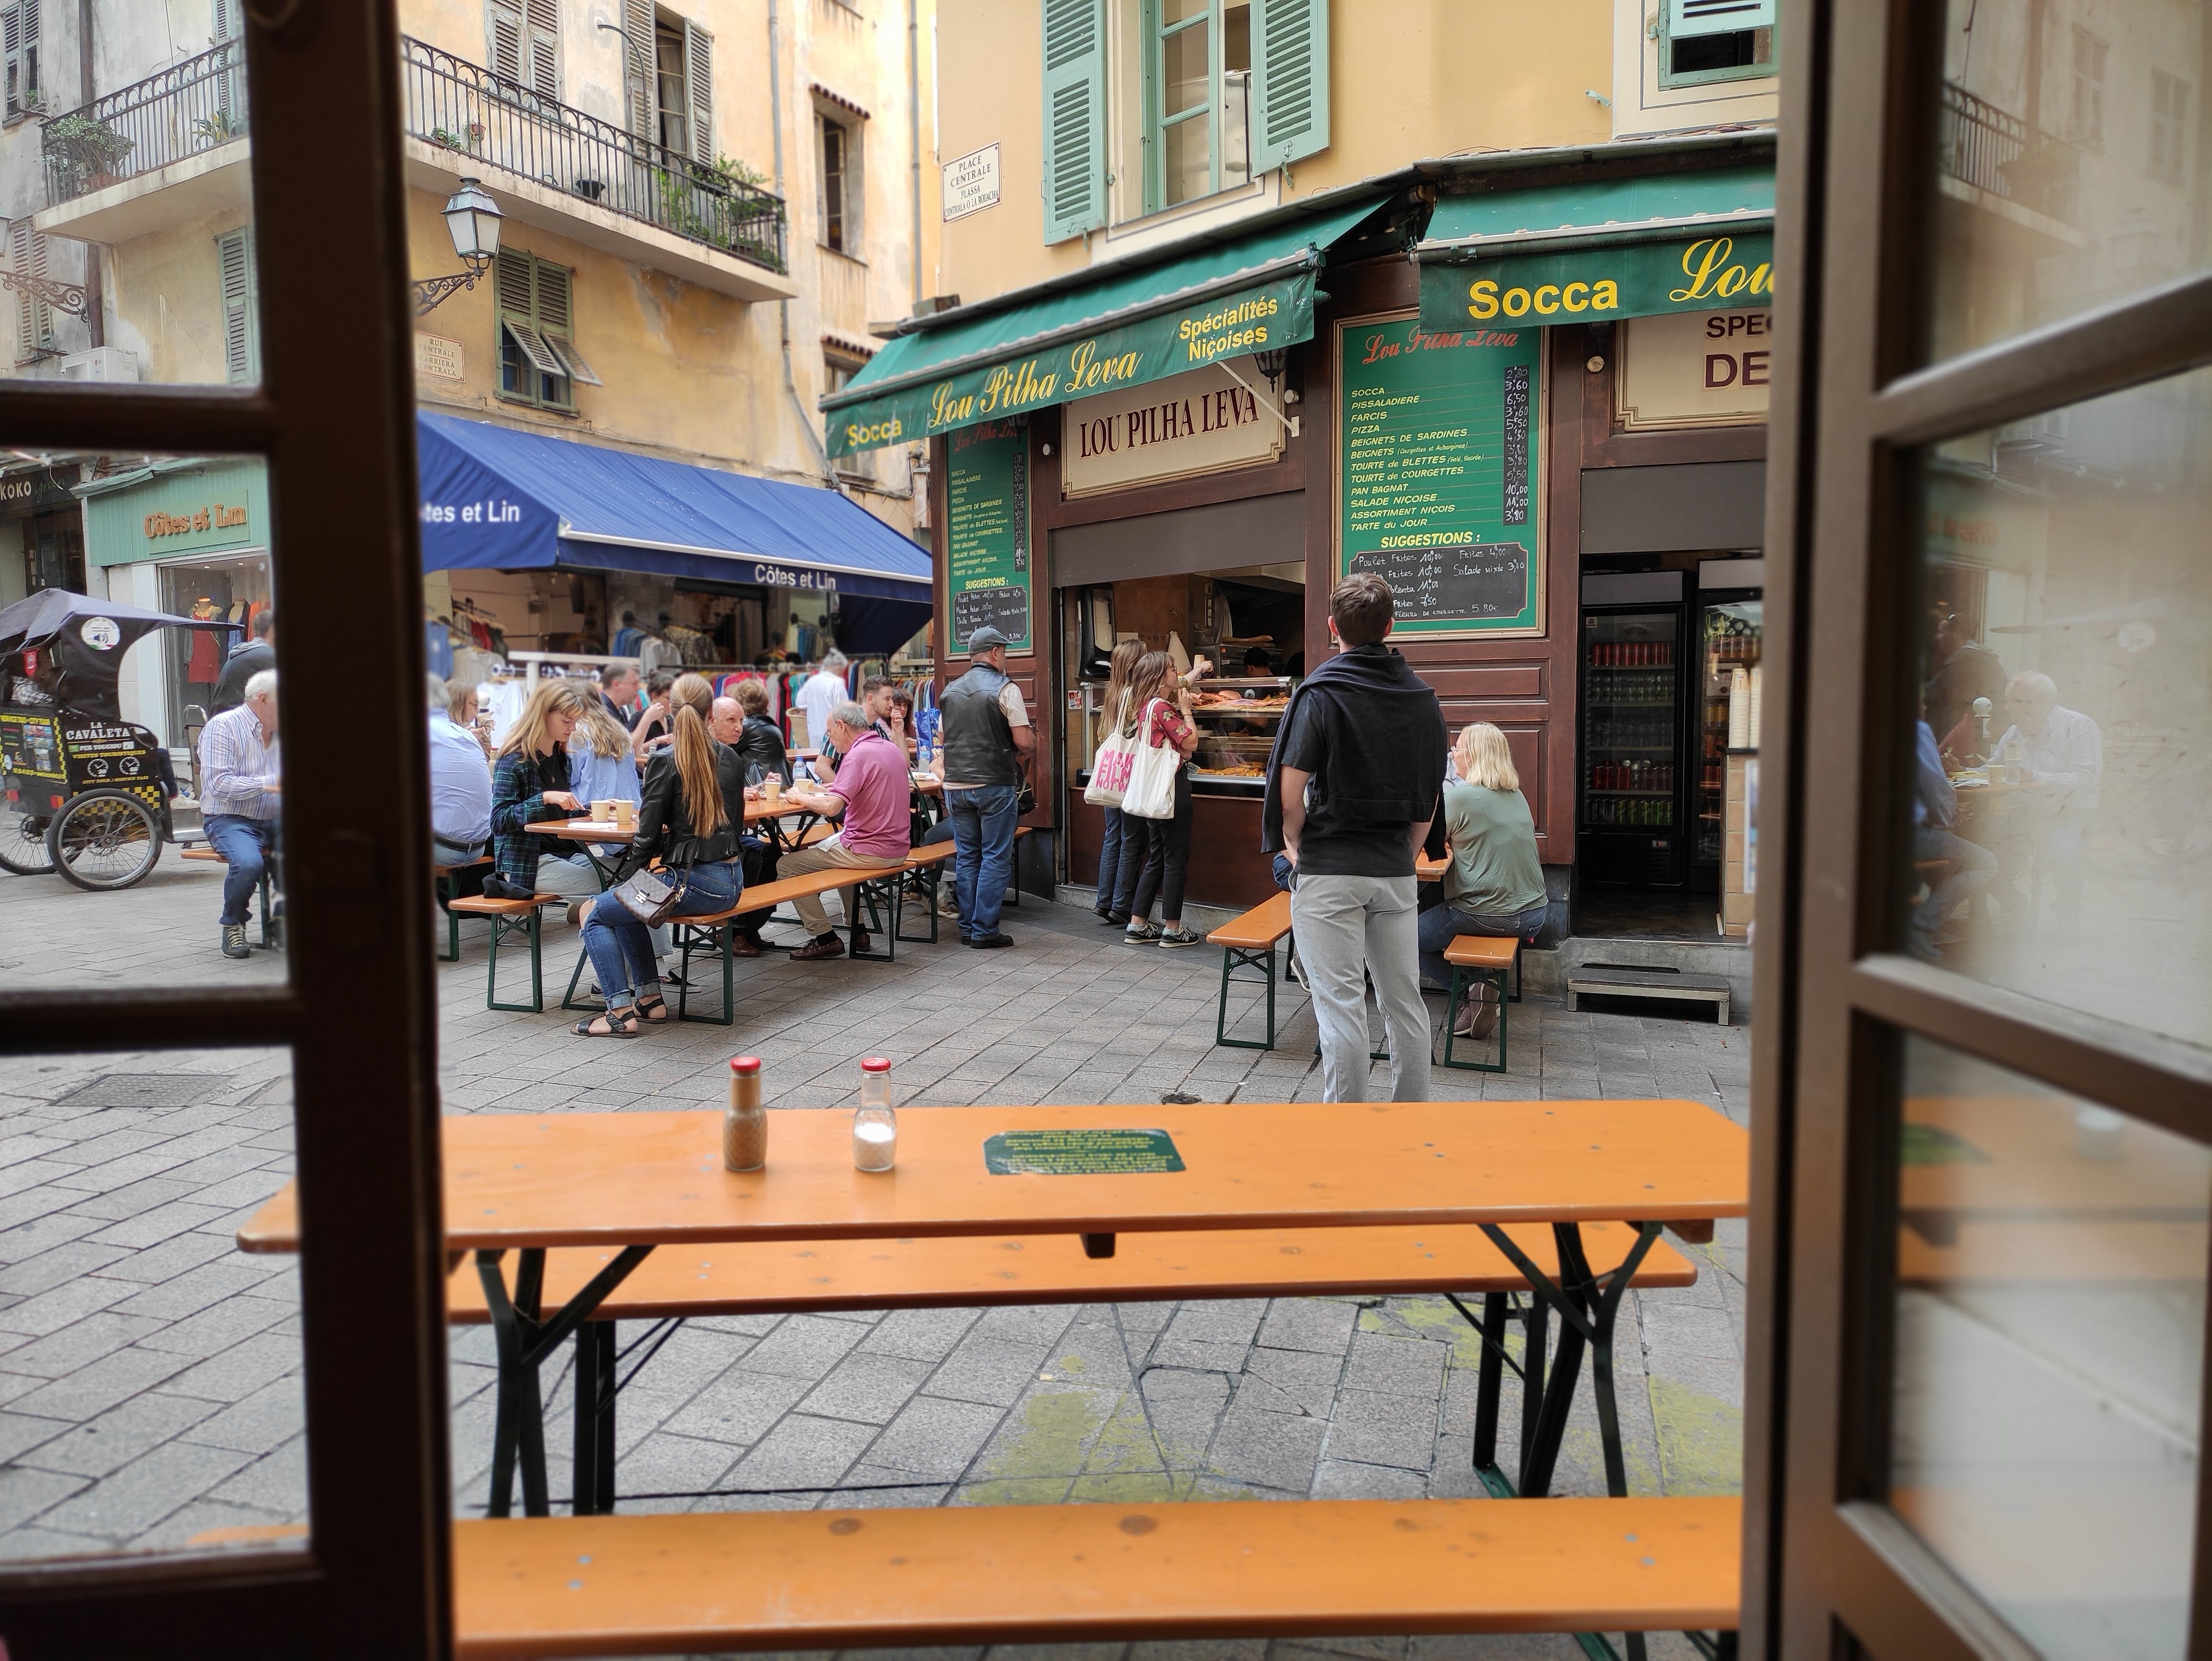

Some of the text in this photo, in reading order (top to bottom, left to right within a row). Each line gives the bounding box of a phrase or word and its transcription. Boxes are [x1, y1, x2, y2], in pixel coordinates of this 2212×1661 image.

[959, 155, 982, 172] PLACE
[951, 163, 991, 187] CENTRALE
[961, 185, 980, 199] PLASSA
[944, 202, 966, 217] CENTRALA
[971, 198, 977, 208] LA
[1468, 237, 1774, 320] Socca Lou
[1179, 296, 1278, 341] Spécialités
[430, 338, 443, 347] RUE
[1189, 326, 1268, 362] Niçoises
[1362, 334, 1400, 365] Lou
[420, 344, 455, 358] NTRALE
[420, 355, 455, 368] RRIERA
[420, 363, 456, 376] NTRALA
[848, 340, 1144, 447] Socca Lou Pilha Leva
[1351, 387, 1385, 398] SOCCA
[1351, 395, 1420, 410] PISSALADIERE
[1080, 383, 1260, 458] LOU PILHA LEVA
[1351, 411, 1387, 423] FARCIS
[1351, 424, 1380, 435] PIZZA
[1351, 428, 1468, 448] BEIGNETS DE SARDINES
[1350, 447, 1394, 459] BEIGNETS
[1351, 461, 1385, 471] TOURTE
[1388, 460, 1399, 468] de
[1402, 455, 1446, 467] BLETTES
[951, 469, 965, 477] SOCCA
[951, 474, 982, 486] PISSALADIÈRE
[1351, 466, 1464, 484] TOURTE de COURGETTES
[0, 481, 32, 500] KOKO
[951, 487, 967, 495] FARCIS
[1351, 483, 1409, 496] PAN BAGNAT
[952, 497, 964, 505] PIZZA
[952, 504, 973, 514] BEIGNETS
[981, 498, 1003, 507] SARDINES
[1350, 493, 1438, 508] SALADE NIÇOISE
[421, 500, 520, 522] tes et Lin
[952, 513, 973, 523] BEIGNETS
[1350, 504, 1455, 520] ASSORTIMENT NIÇOIS
[144, 504, 247, 538] Côtes et Lin
[952, 523, 968, 532] TOURTE
[975, 519, 995, 528] BLETTES
[1351, 519, 1428, 532] TARTE du JOUR
[952, 532, 968, 541] TOURTE
[975, 527, 1003, 537] COURGETTES
[953, 551, 968, 559] SALADE
[1359, 555, 1387, 567] Poulet
[953, 558, 981, 568] ASSORTIMENT
[1453, 564, 1482, 576] Salade
[755, 564, 836, 590] Côtes et Lin
[66, 728, 131, 740] CAVALETA
[1100, 749, 1136, 768] MAK
[1096, 778, 1115, 791] NOT
